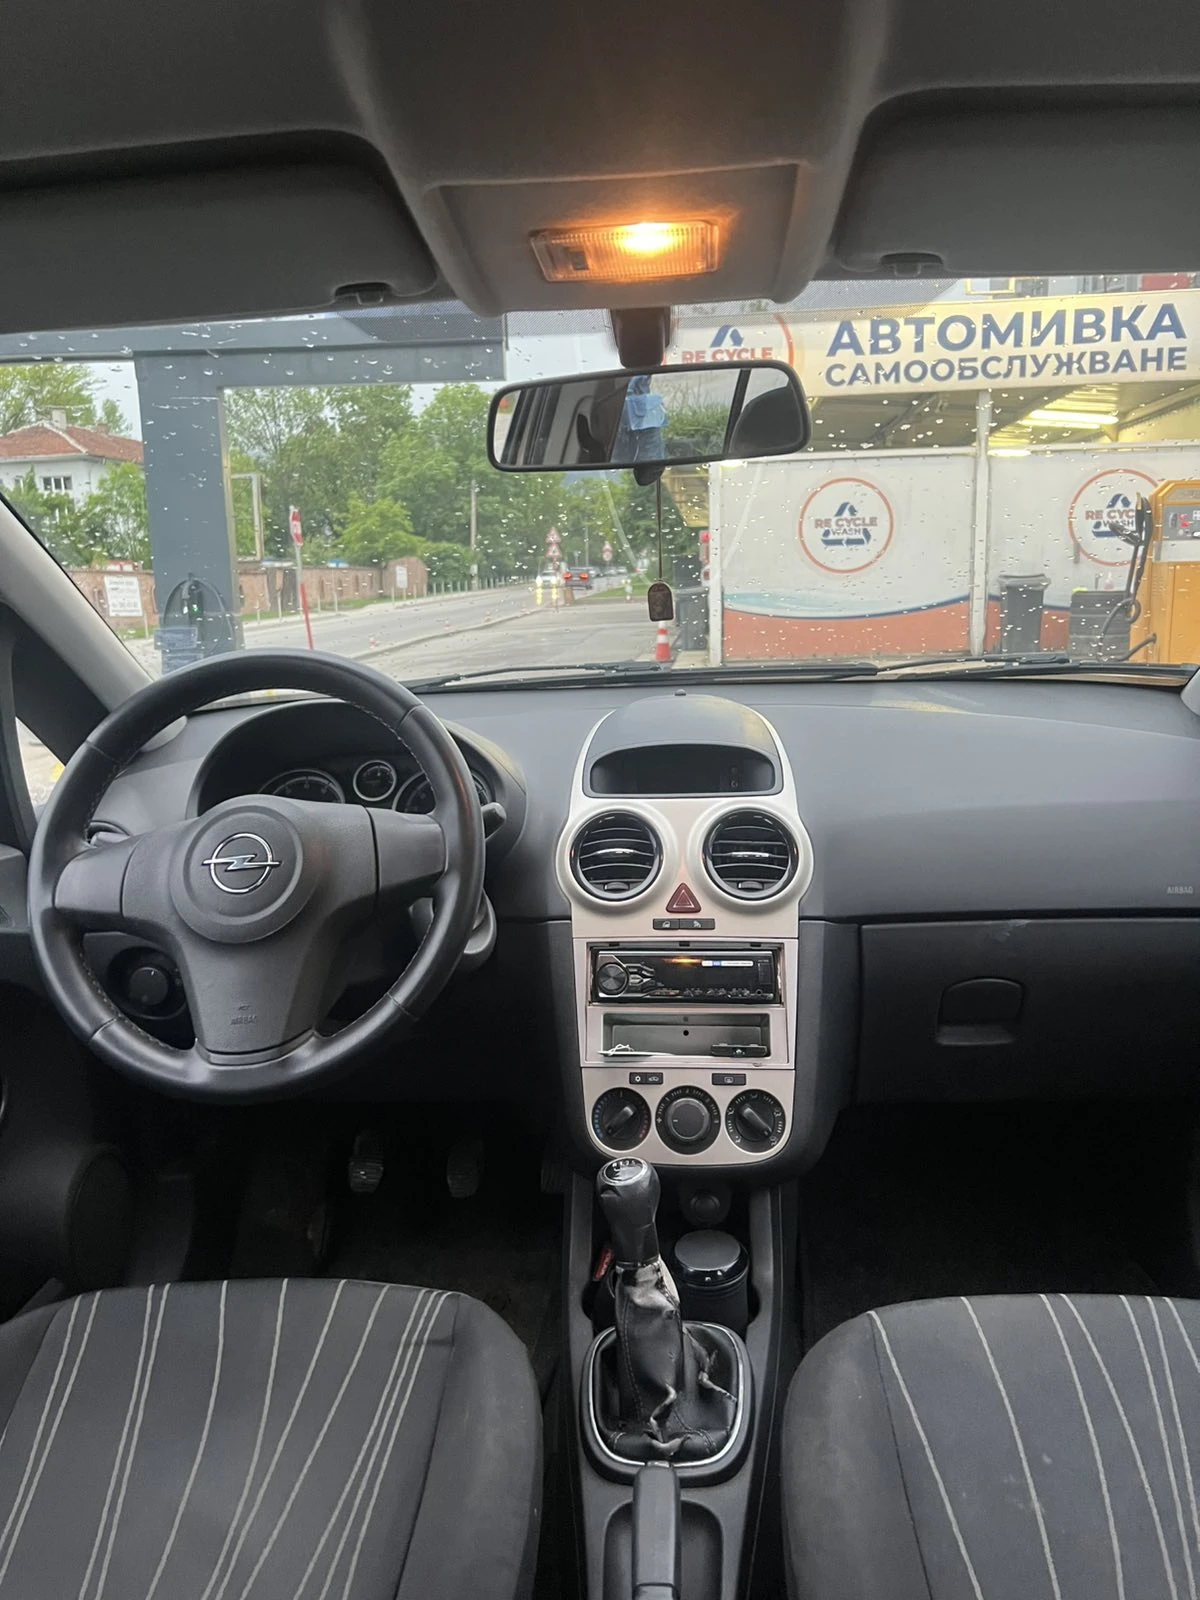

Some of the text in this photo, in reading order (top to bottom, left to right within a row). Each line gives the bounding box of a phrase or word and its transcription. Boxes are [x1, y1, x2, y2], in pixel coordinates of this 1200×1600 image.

[826, 303, 1187, 358] АВТОМИВКА
[681, 346, 773, 364] RE CYCLE
[825, 347, 1188, 387] САМООБСЛУЖВАНЕ
[1085, 509, 1136, 520] RE CYC
[814, 517, 878, 528] RE CYCLE
[831, 528, 861, 536] WASH
